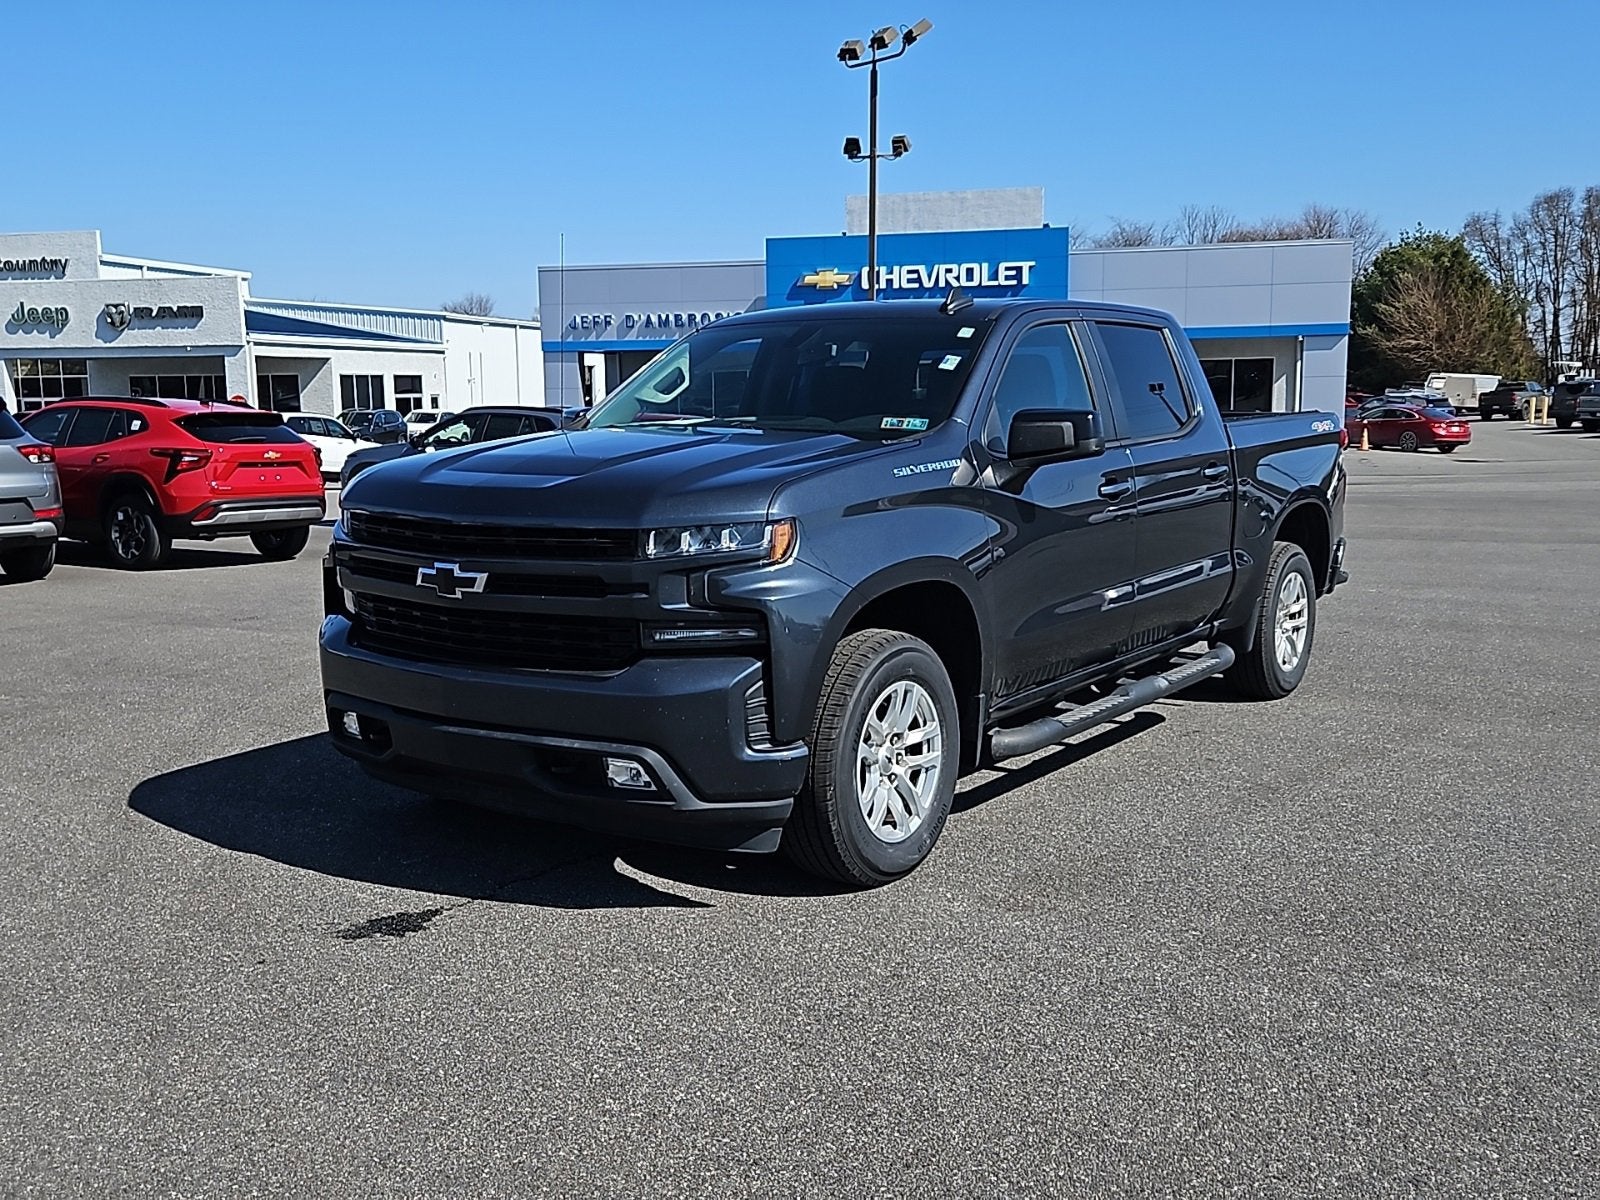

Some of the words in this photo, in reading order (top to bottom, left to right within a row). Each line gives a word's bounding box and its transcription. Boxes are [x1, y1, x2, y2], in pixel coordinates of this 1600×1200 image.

[0, 256, 69, 275] ountry
[861, 261, 1036, 290] CHEVROLET
[11, 301, 69, 328] Jeep
[132, 306, 203, 319] RAM
[569, 314, 613, 330] JEFF
[625, 311, 743, 329] D'AMBRO
[892, 458, 961, 478] SILVERADO
